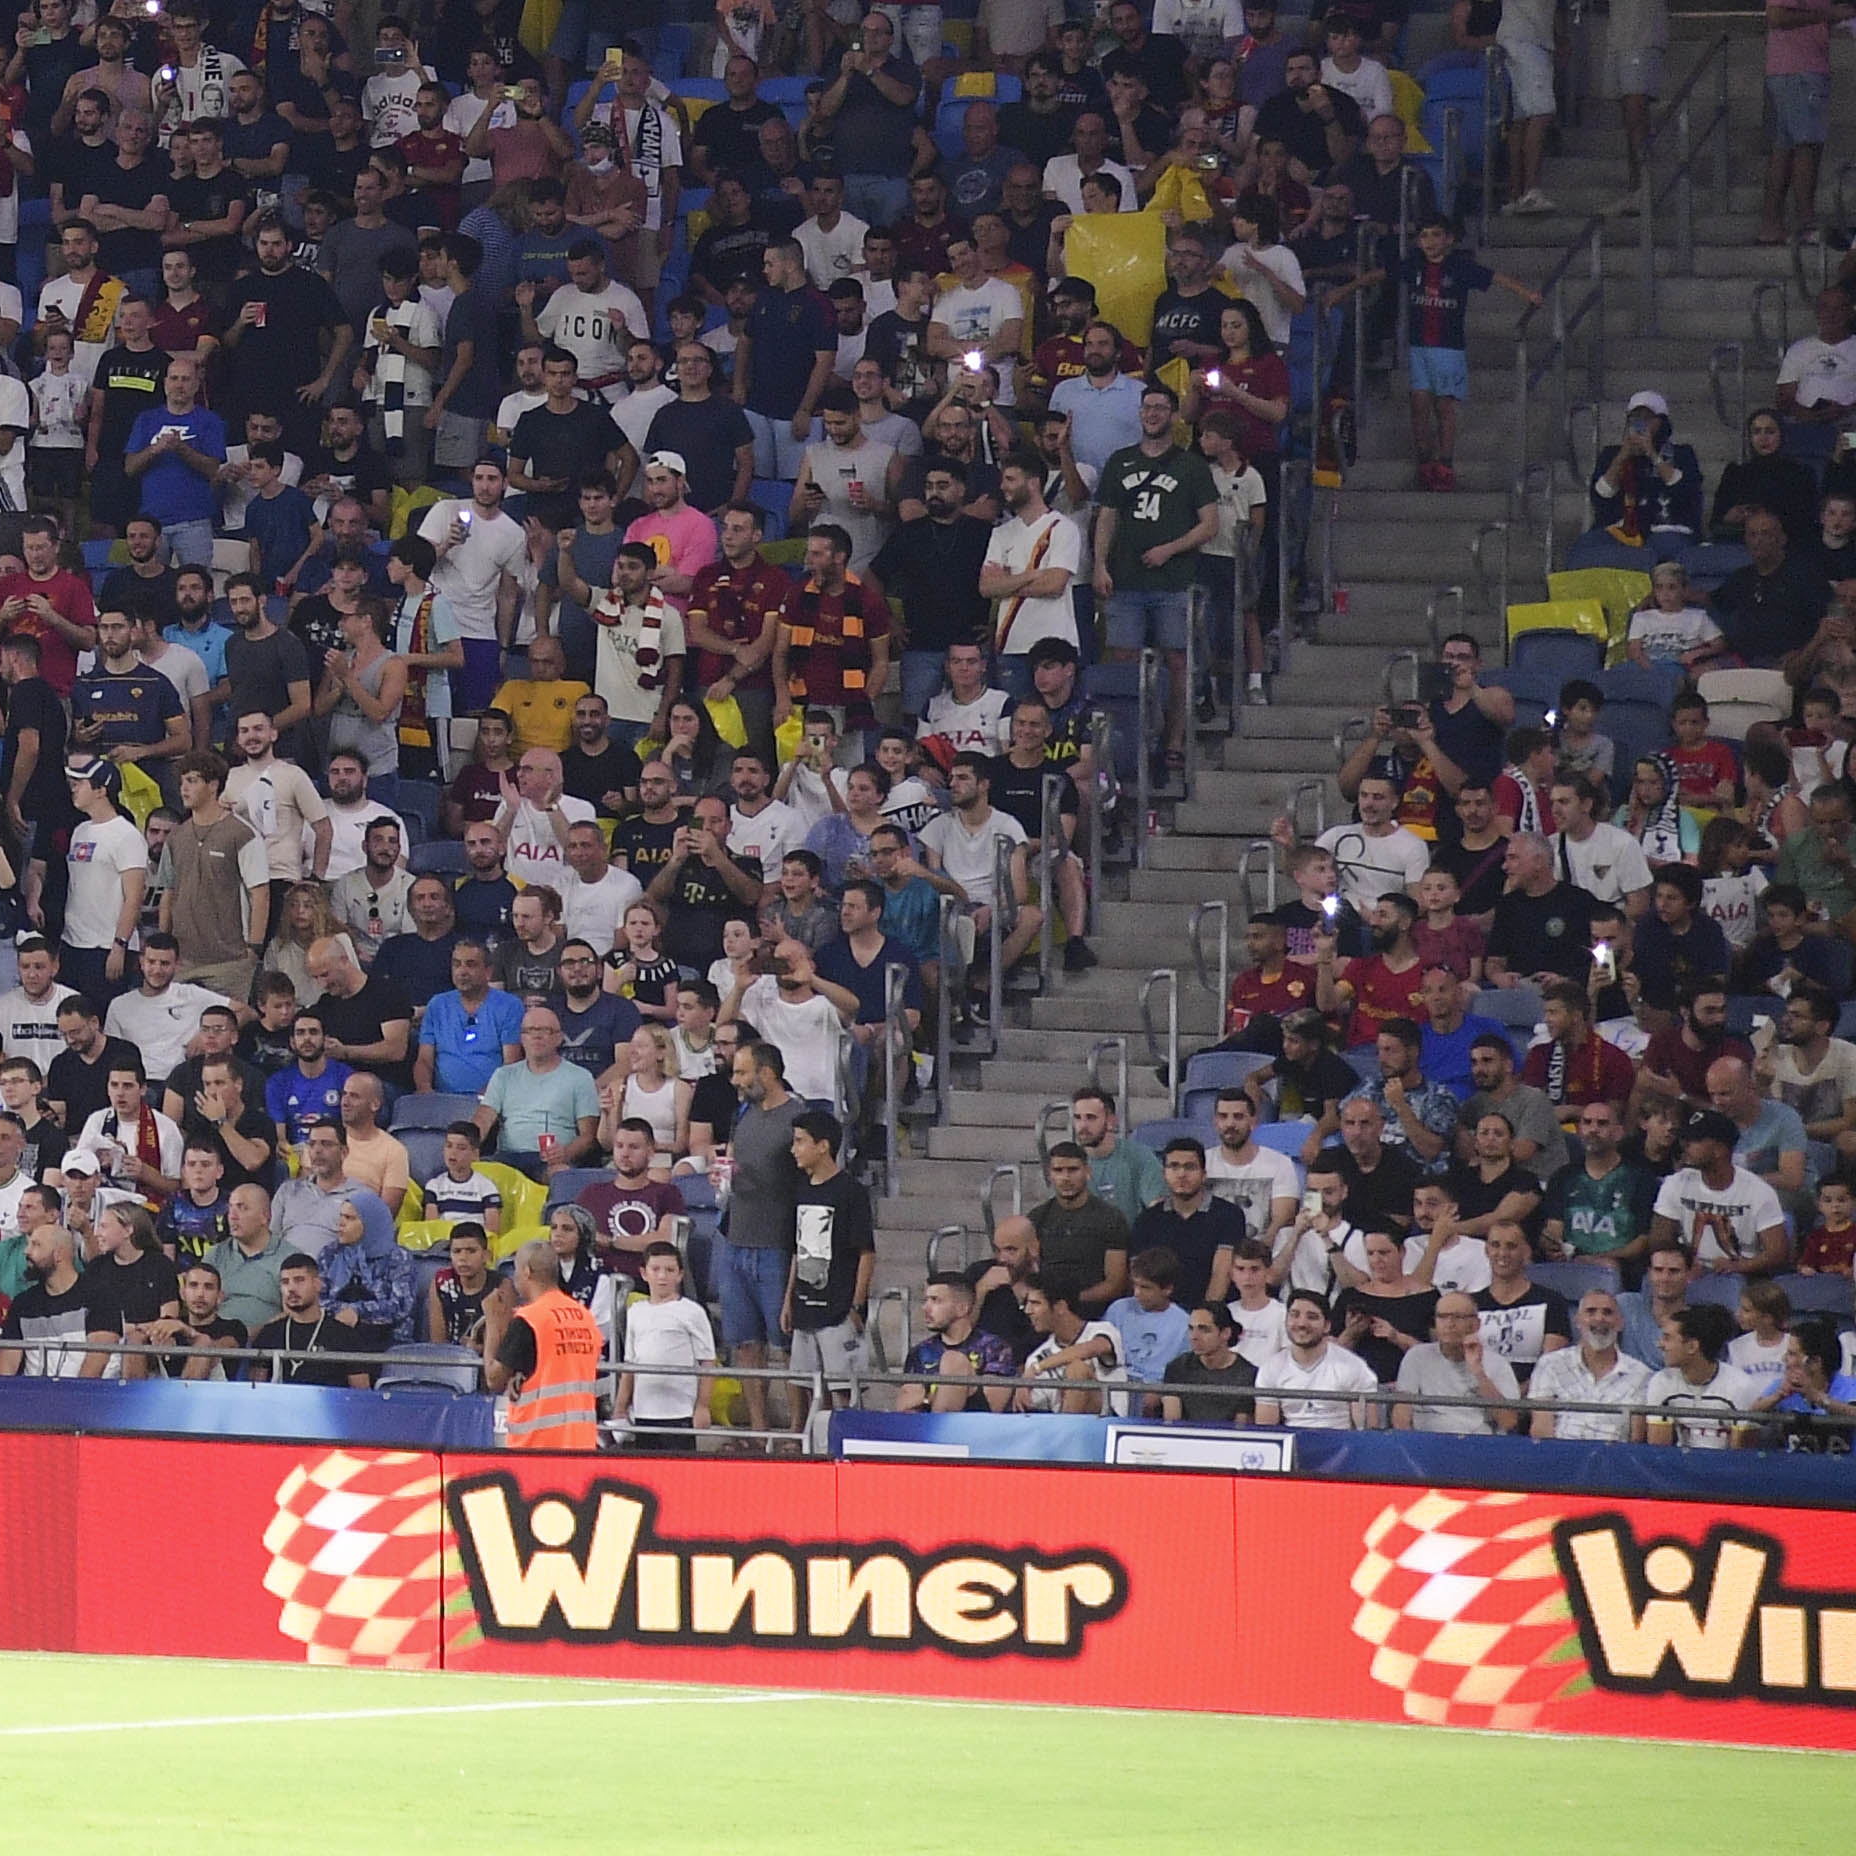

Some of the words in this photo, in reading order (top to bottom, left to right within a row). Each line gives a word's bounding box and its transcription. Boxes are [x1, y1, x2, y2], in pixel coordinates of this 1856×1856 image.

[1156, 313, 1201, 330] MCFC
[1133, 490, 1161, 523] 34
[514, 843, 560, 863] AIA
[635, 848, 674, 865] AIA
[1711, 902, 1750, 921] AIA
[1571, 1210, 1617, 1238] AIA
[460, 1486, 1114, 1646] Winner
